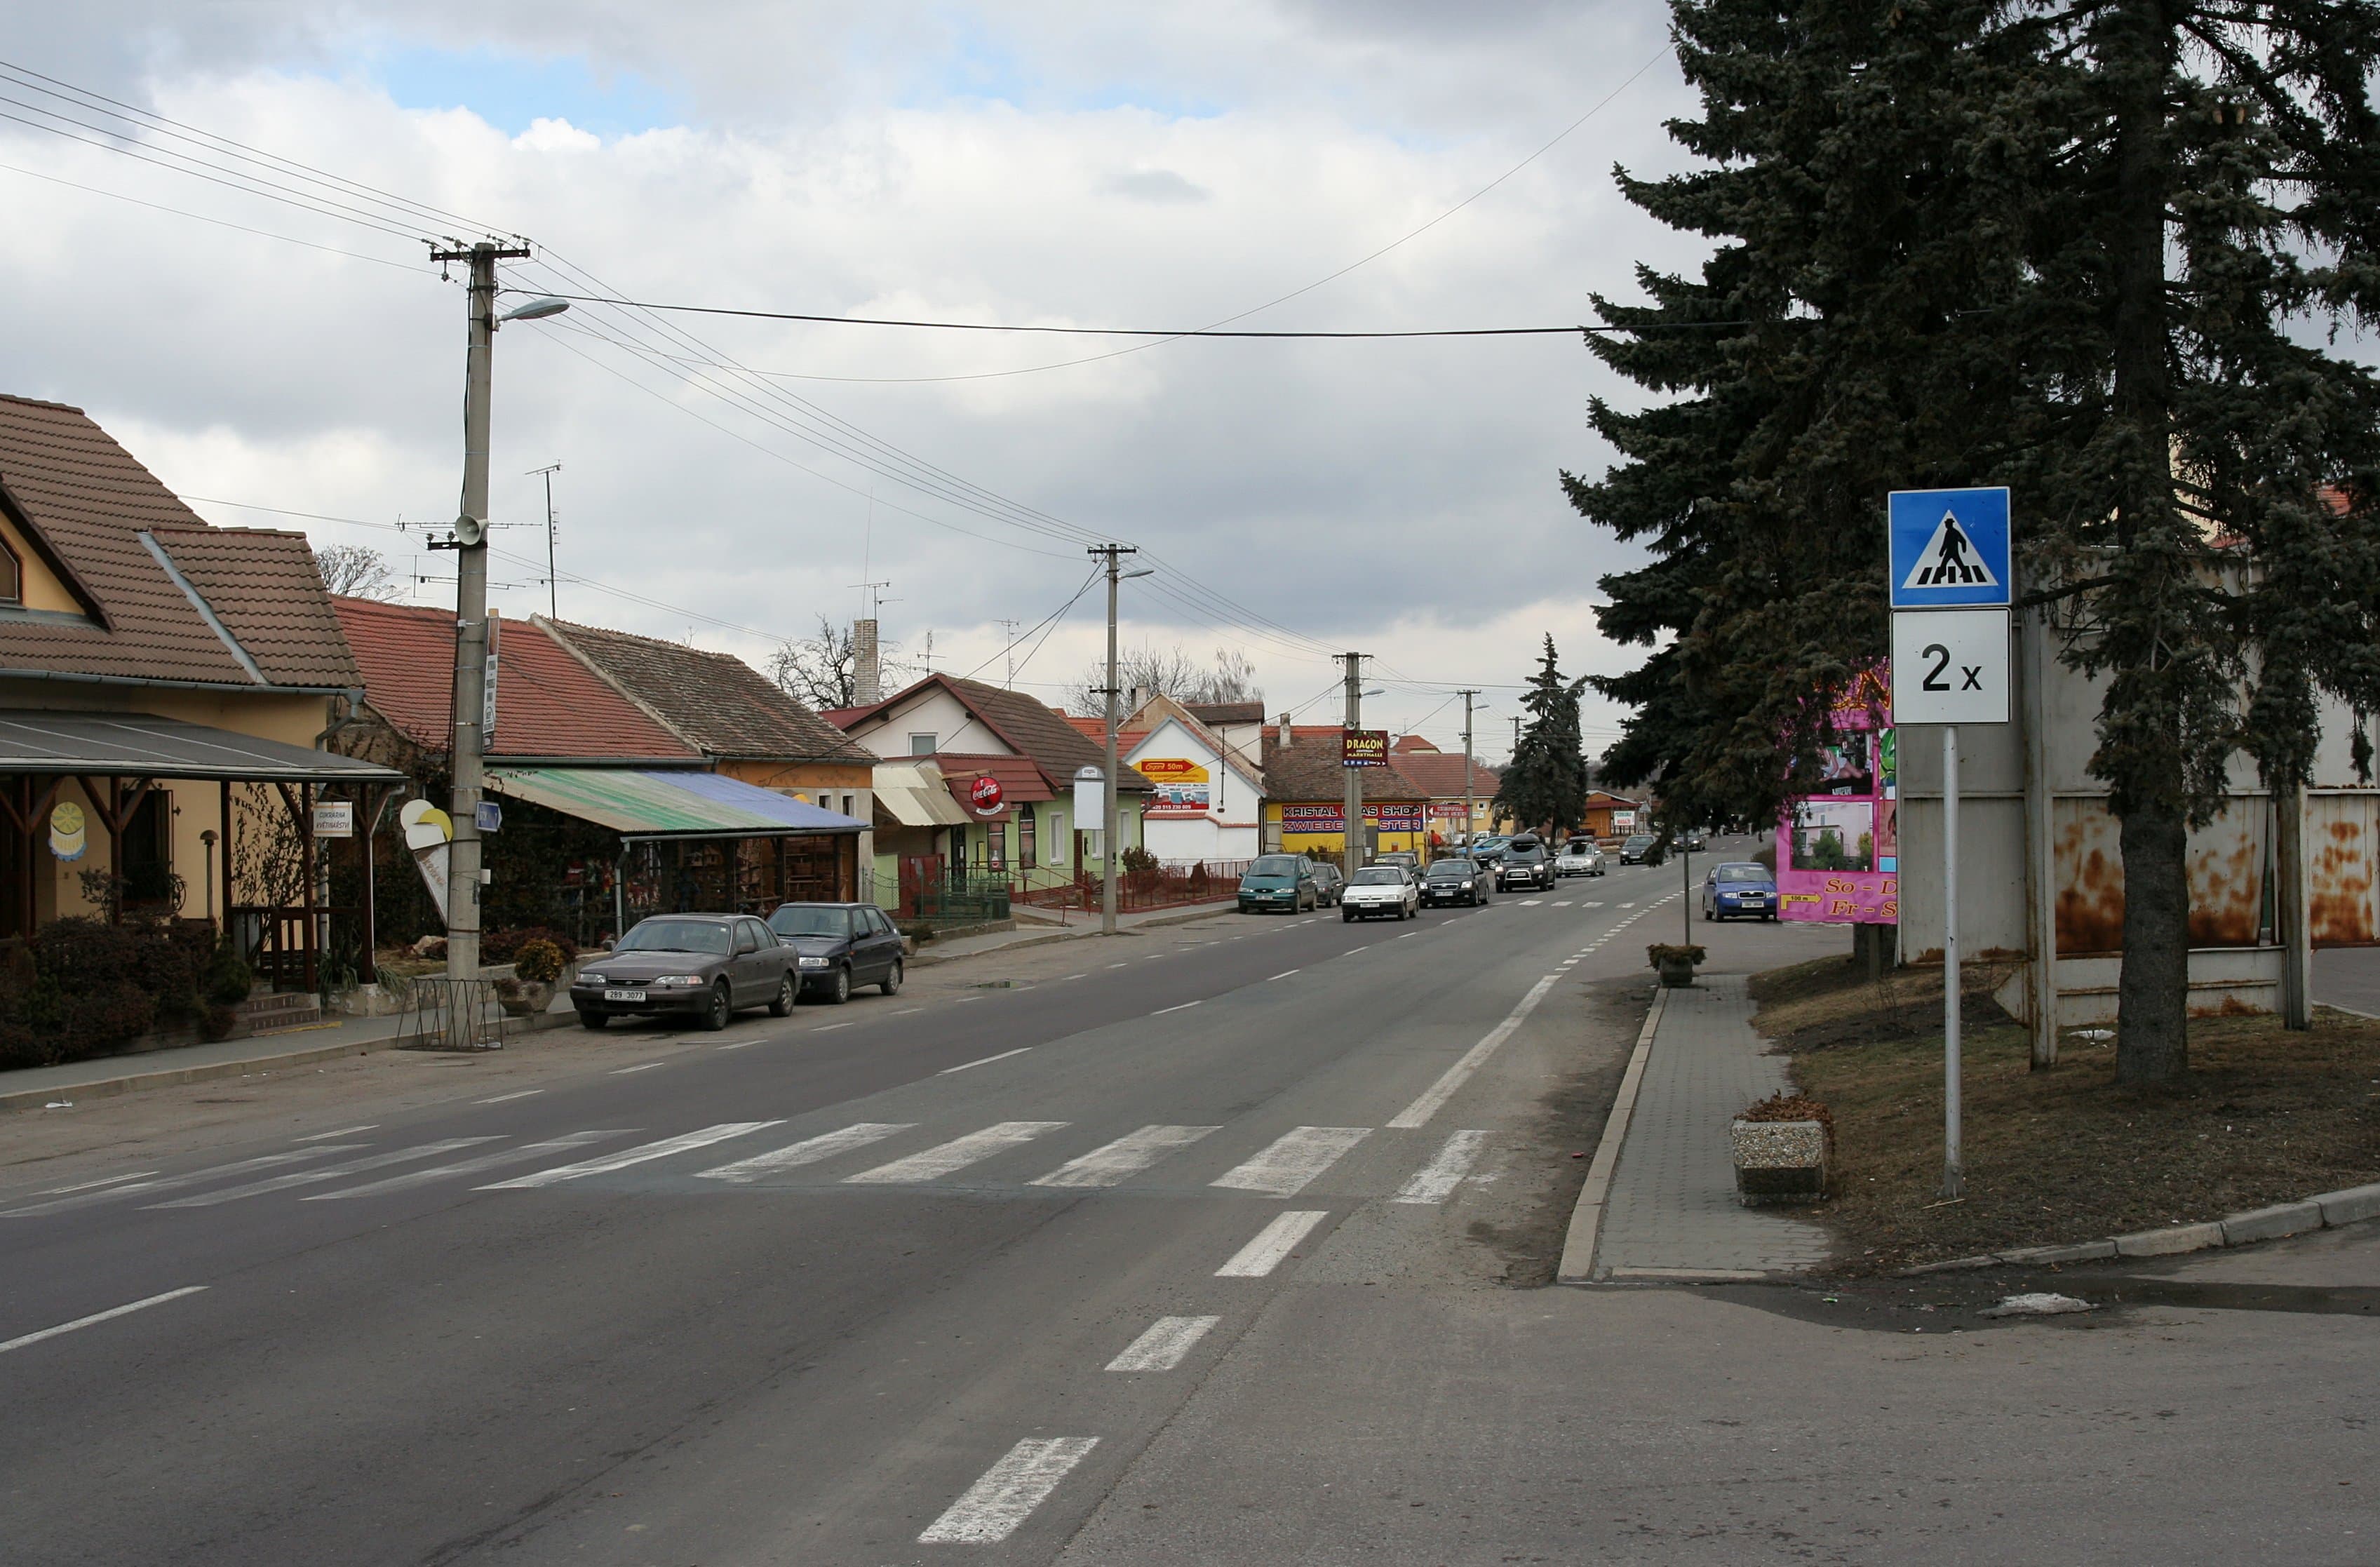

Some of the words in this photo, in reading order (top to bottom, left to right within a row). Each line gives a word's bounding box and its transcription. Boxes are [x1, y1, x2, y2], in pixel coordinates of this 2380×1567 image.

[1922, 643, 1950, 691] 2
[1961, 666, 1982, 690] x
[1347, 739, 1384, 749] DRAGON
[972, 784, 997, 800] Coca-Cola
[1284, 807, 1337, 816] KRISTAL
[1383, 806, 1420, 816] SHOP
[1284, 820, 1344, 830] ZWIEBE
[1825, 877, 1855, 894] So
[1880, 880, 1897, 894] D
[1829, 900, 1858, 915] Fr
[1881, 901, 1897, 917] S
